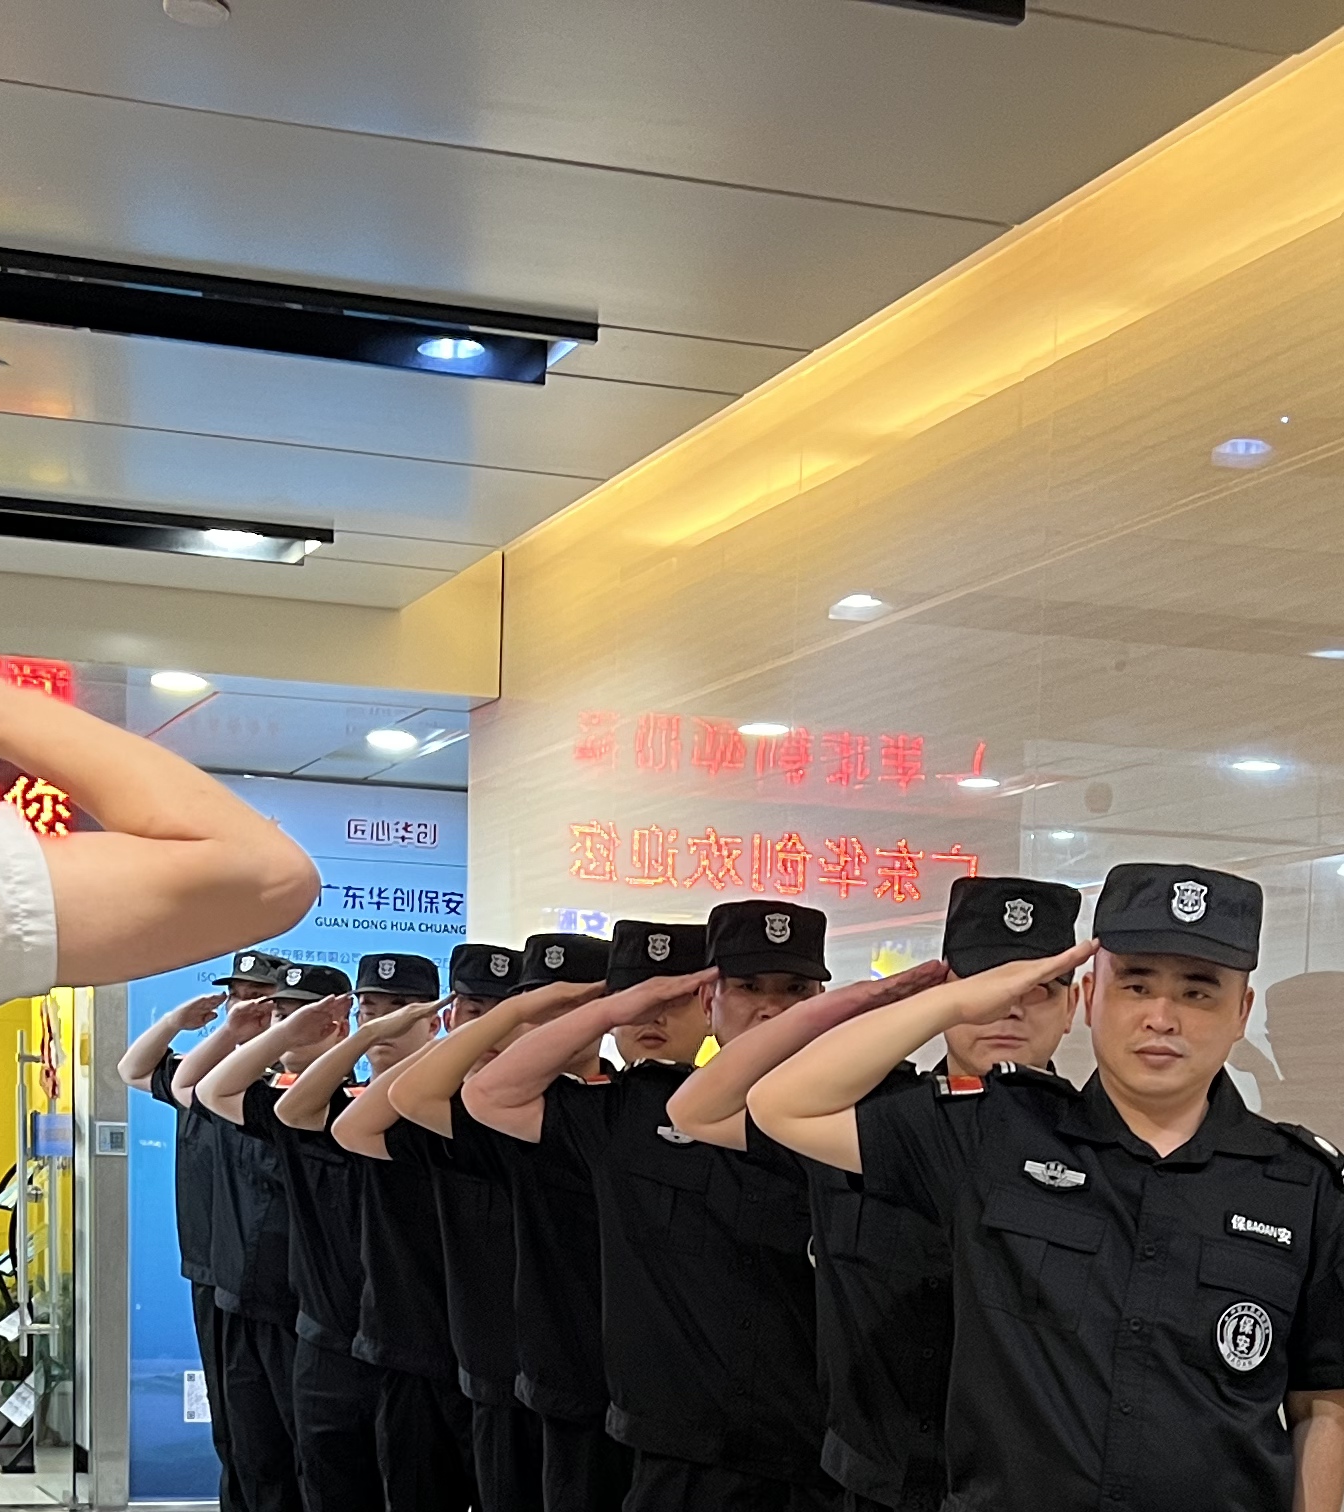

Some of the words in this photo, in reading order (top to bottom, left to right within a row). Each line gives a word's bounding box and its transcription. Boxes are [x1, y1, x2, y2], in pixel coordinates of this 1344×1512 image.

[347, 818, 438, 845] 匠心华创
[315, 916, 349, 929] GUAN
[353, 918, 387, 931] DONG
[391, 920, 416, 933] HUA
[418, 922, 467, 935] CHUANG
[1237, 1316, 1255, 1354] 保安
